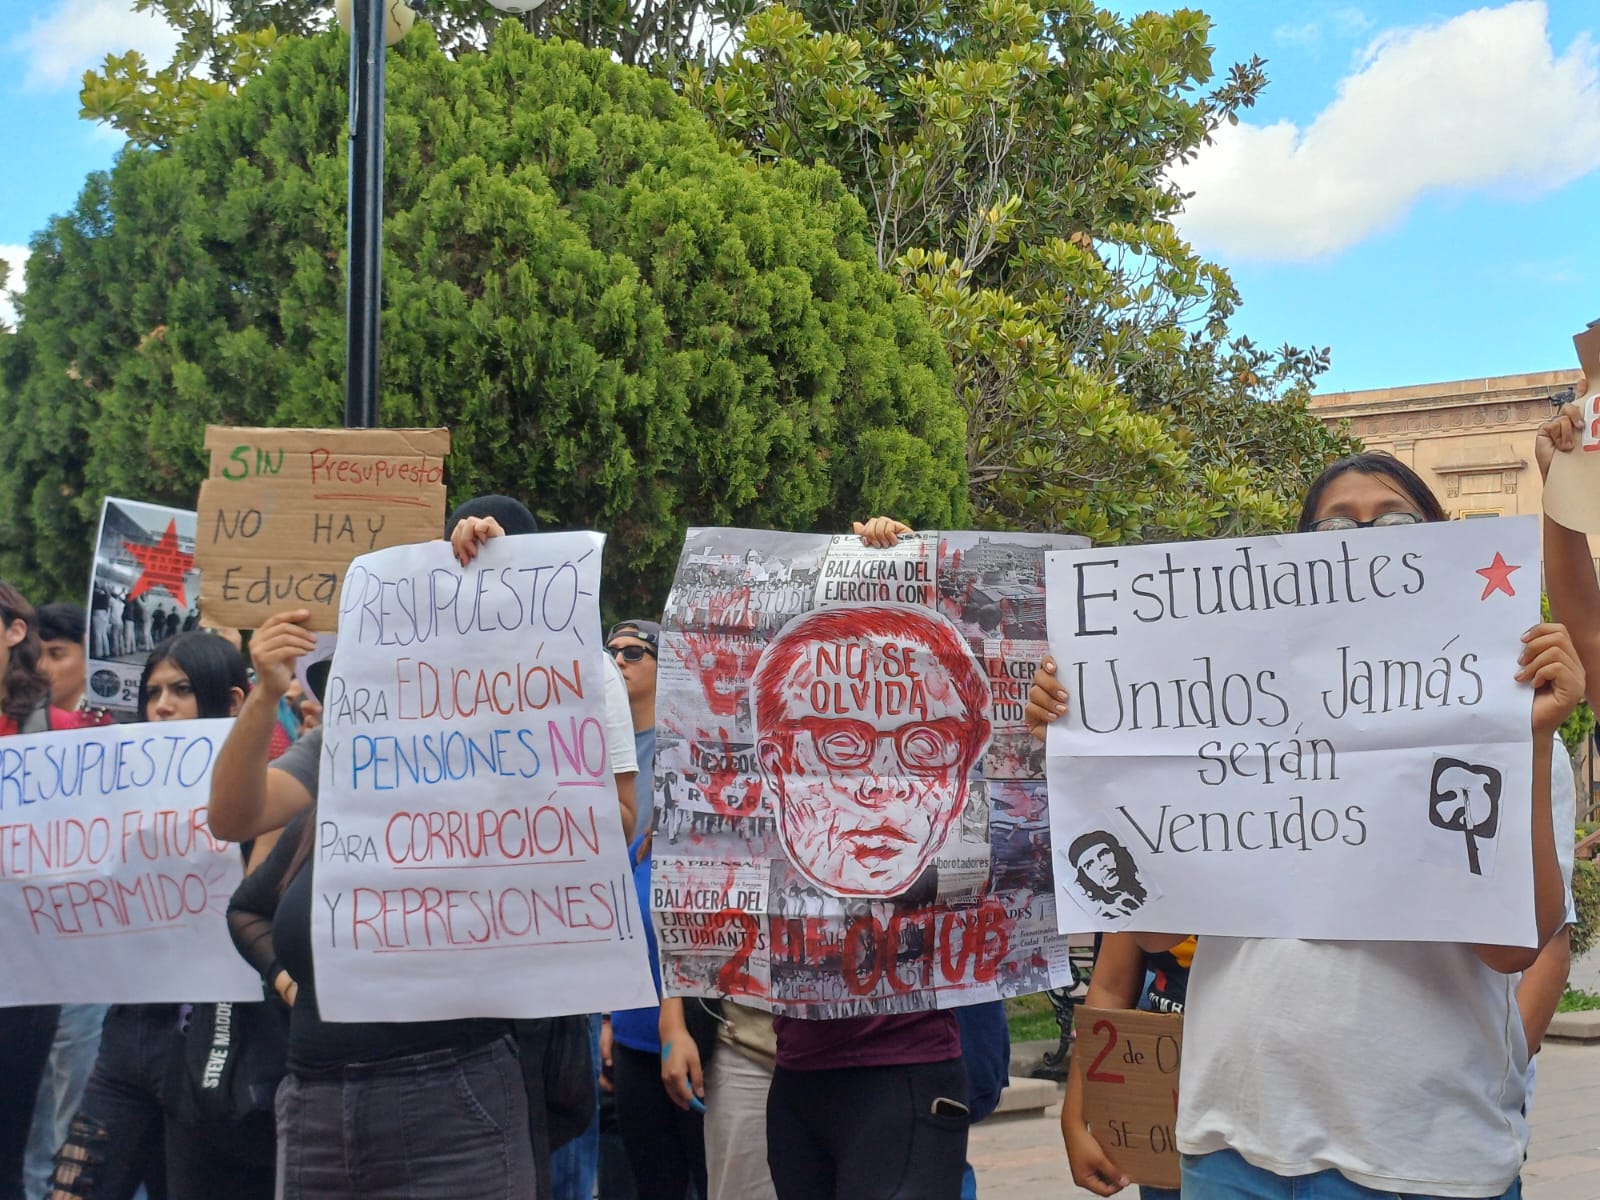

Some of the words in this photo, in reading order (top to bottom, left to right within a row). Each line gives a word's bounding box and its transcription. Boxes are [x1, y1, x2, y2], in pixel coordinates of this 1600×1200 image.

[222, 446, 285, 481] SIN
[309, 447, 444, 488] Presupuesto
[212, 508, 263, 545] NO
[312, 513, 386, 550] HAY
[824, 559, 899, 580] BALACERA
[903, 560, 932, 582] DEL
[824, 581, 890, 602] EJERCITO
[896, 583, 930, 605] CON
[1072, 540, 1427, 639] Estudiantes
[339, 562, 579, 647] PRESUPUESTO
[328, 676, 390, 728] PARA
[396, 641, 584, 721] EDUCACIÓN
[882, 642, 921, 682] SE
[1071, 656, 1291, 735] Unidos
[1320, 634, 1486, 721] Jamás
[810, 679, 929, 721] OLVIDA
[0, 736, 214, 810] RESUPUESTO
[325, 741, 340, 788] Y
[352, 728, 541, 790] PENSIONES
[547, 715, 607, 778] NO
[1196, 721, 1341, 787] serán
[121, 806, 231, 865] FUTUR
[320, 820, 380, 864] PARA
[385, 790, 600, 865] CORRUPCIÓN
[1115, 796, 1369, 856] Vencidos
[21, 872, 208, 936] REPRIMIDO
[322, 892, 342, 949] Y
[654, 887, 730, 911] BALACERA
[736, 890, 763, 912] DEL
[660, 927, 766, 951] ESTUDIANTS
[202, 1047, 229, 1089] STEVE
[1086, 1019, 1126, 1084] 2
[1123, 1039, 1145, 1065] de
[1108, 1119, 1138, 1150] SE
